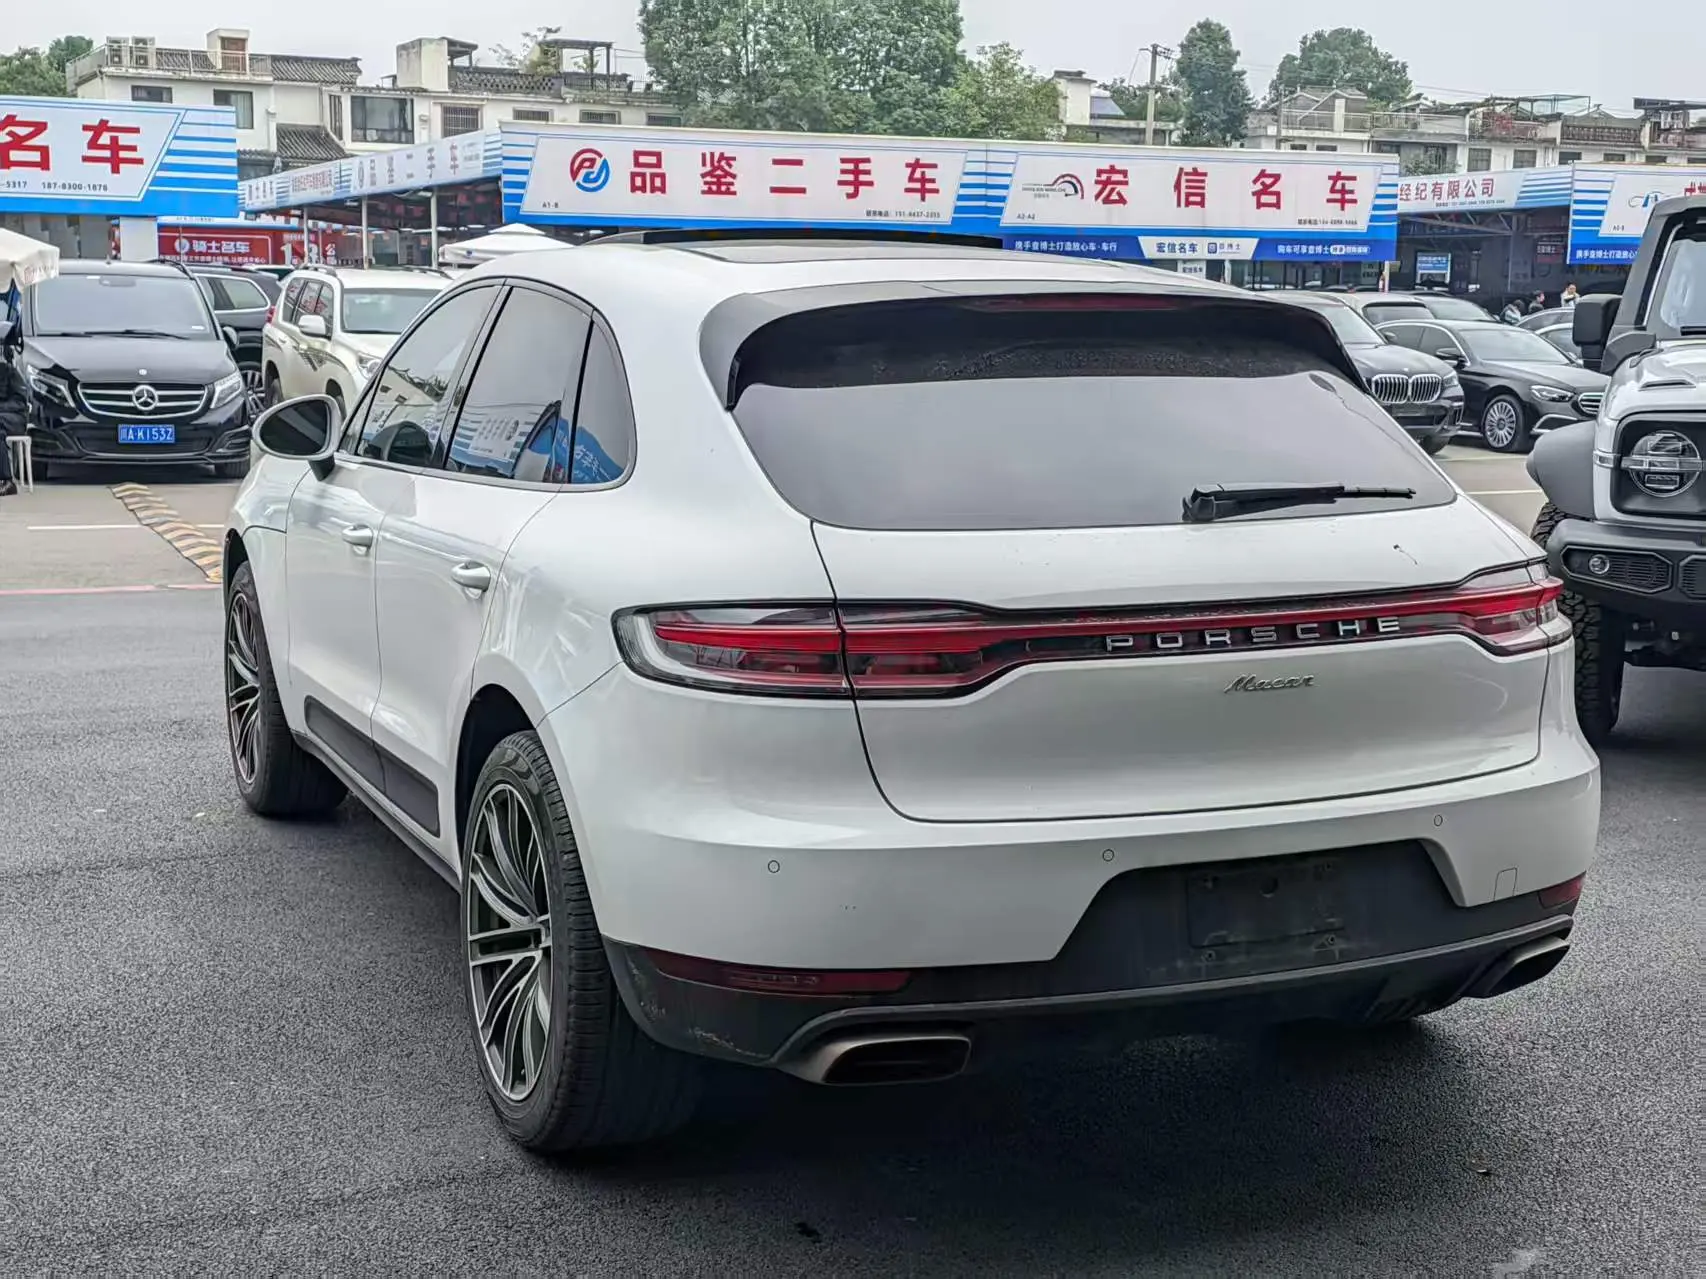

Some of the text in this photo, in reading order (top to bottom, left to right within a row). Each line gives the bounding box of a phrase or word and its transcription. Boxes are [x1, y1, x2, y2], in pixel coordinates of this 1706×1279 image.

[0, 114, 144, 174] 名车
[630, 149, 940, 202] 品鉴二手车
[1094, 164, 1359, 212] 宏信名车
[1399, 178, 1495, 202] 经纪有限公司
[192, 240, 250, 254] 骑士名车
[1156, 242, 1198, 254] 宏信名车
[1106, 616, 1400, 651] PORSCHE
[1223, 674, 1315, 694] Macan
